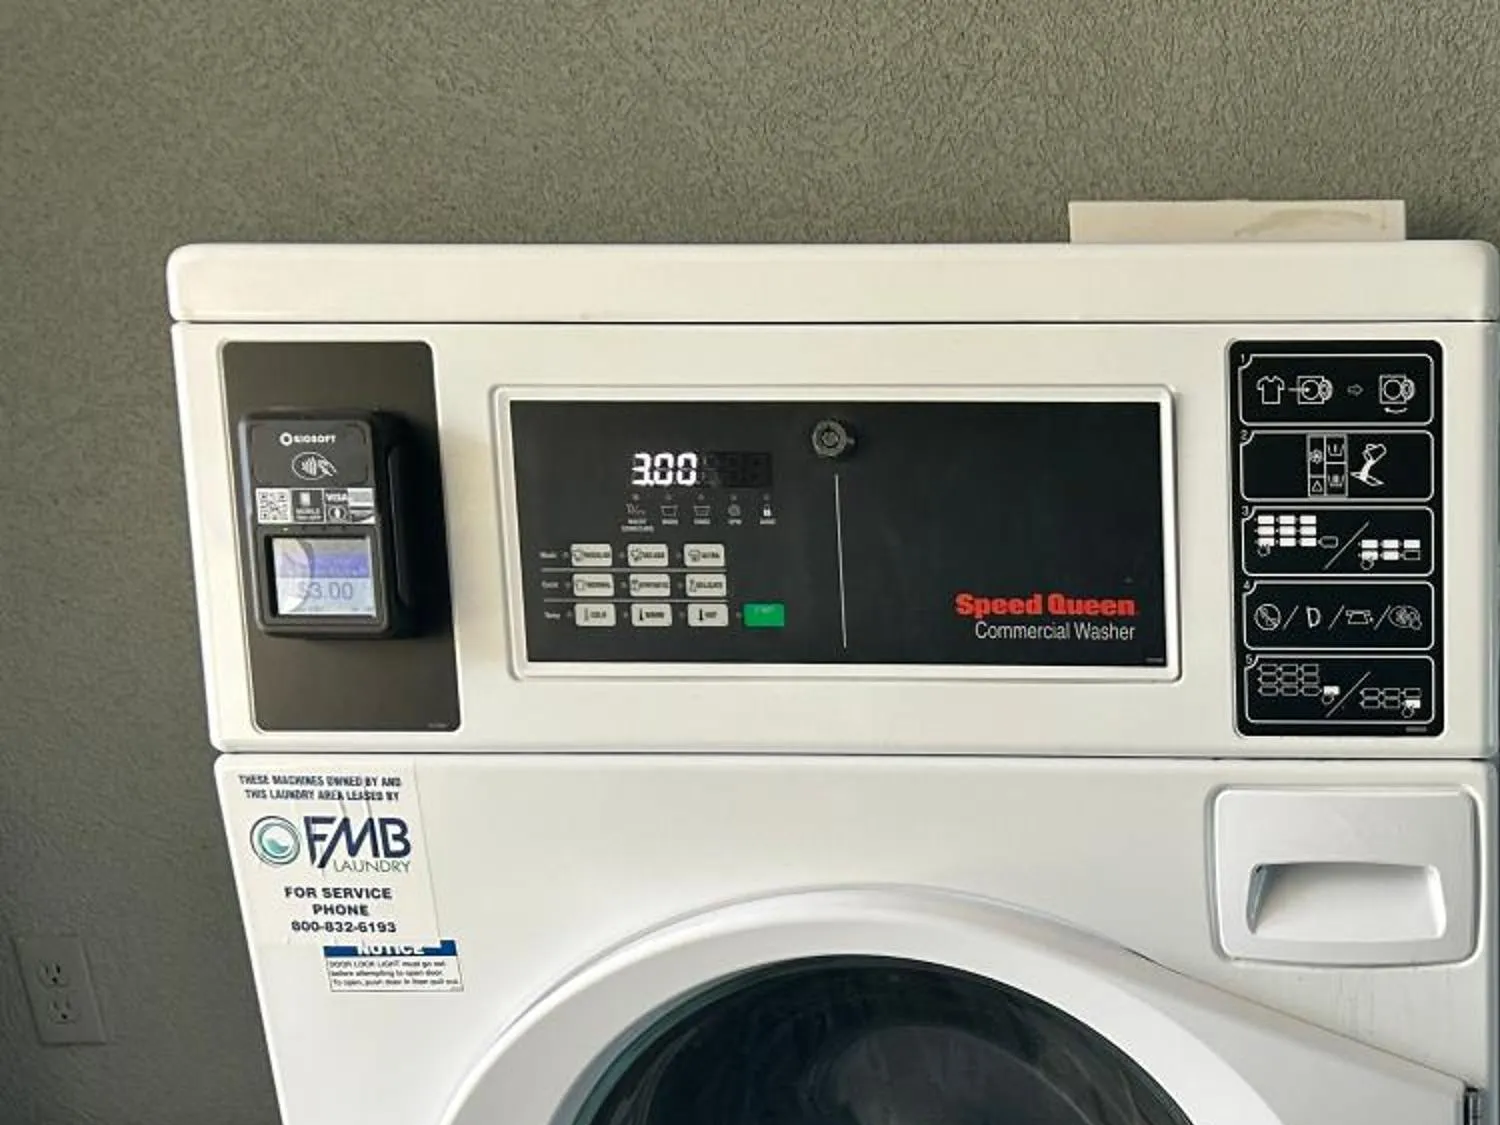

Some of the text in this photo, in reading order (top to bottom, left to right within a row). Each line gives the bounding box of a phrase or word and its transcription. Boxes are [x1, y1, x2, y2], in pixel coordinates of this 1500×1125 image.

[1241, 430, 1248, 441] 2
[1241, 506, 1249, 516] 3
[955, 593, 1136, 618] Speed Queen
[975, 621, 1137, 641] Commercial Washer
[1245, 654, 1253, 666] 5
[238, 775, 402, 787] THESE MACHINES OWNED BY AND
[245, 789, 400, 801] THIS LAUNDRY AREA LEASED BY
[303, 815, 411, 869] FMB
[333, 860, 411, 873] LAUNDRY
[284, 886, 393, 899] FOR SERVICE
[312, 903, 370, 916] PHONE
[291, 920, 397, 933] 800-832-6193
